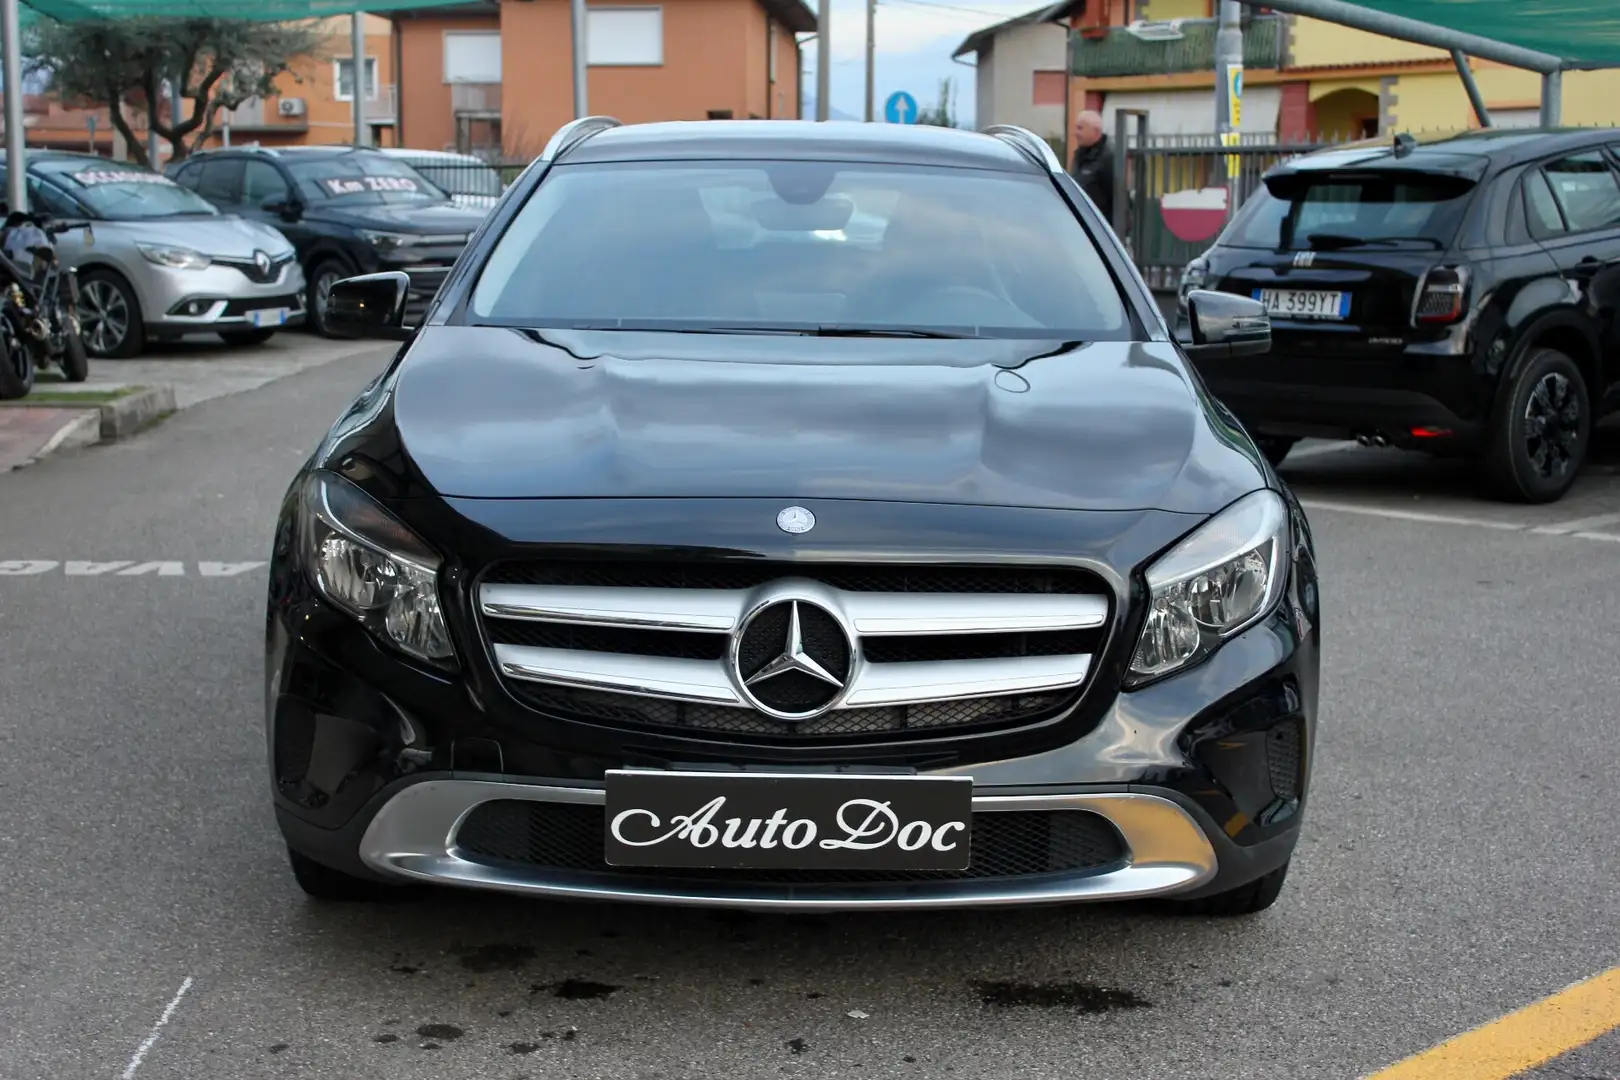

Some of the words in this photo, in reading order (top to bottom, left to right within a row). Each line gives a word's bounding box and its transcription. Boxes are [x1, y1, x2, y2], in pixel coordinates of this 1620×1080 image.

[326, 179, 365, 194] Km
[363, 176, 417, 192] ZERO
[1286, 291, 1339, 313] 399YT
[610, 796, 818, 849] Auto
[818, 798, 966, 851] Doc
